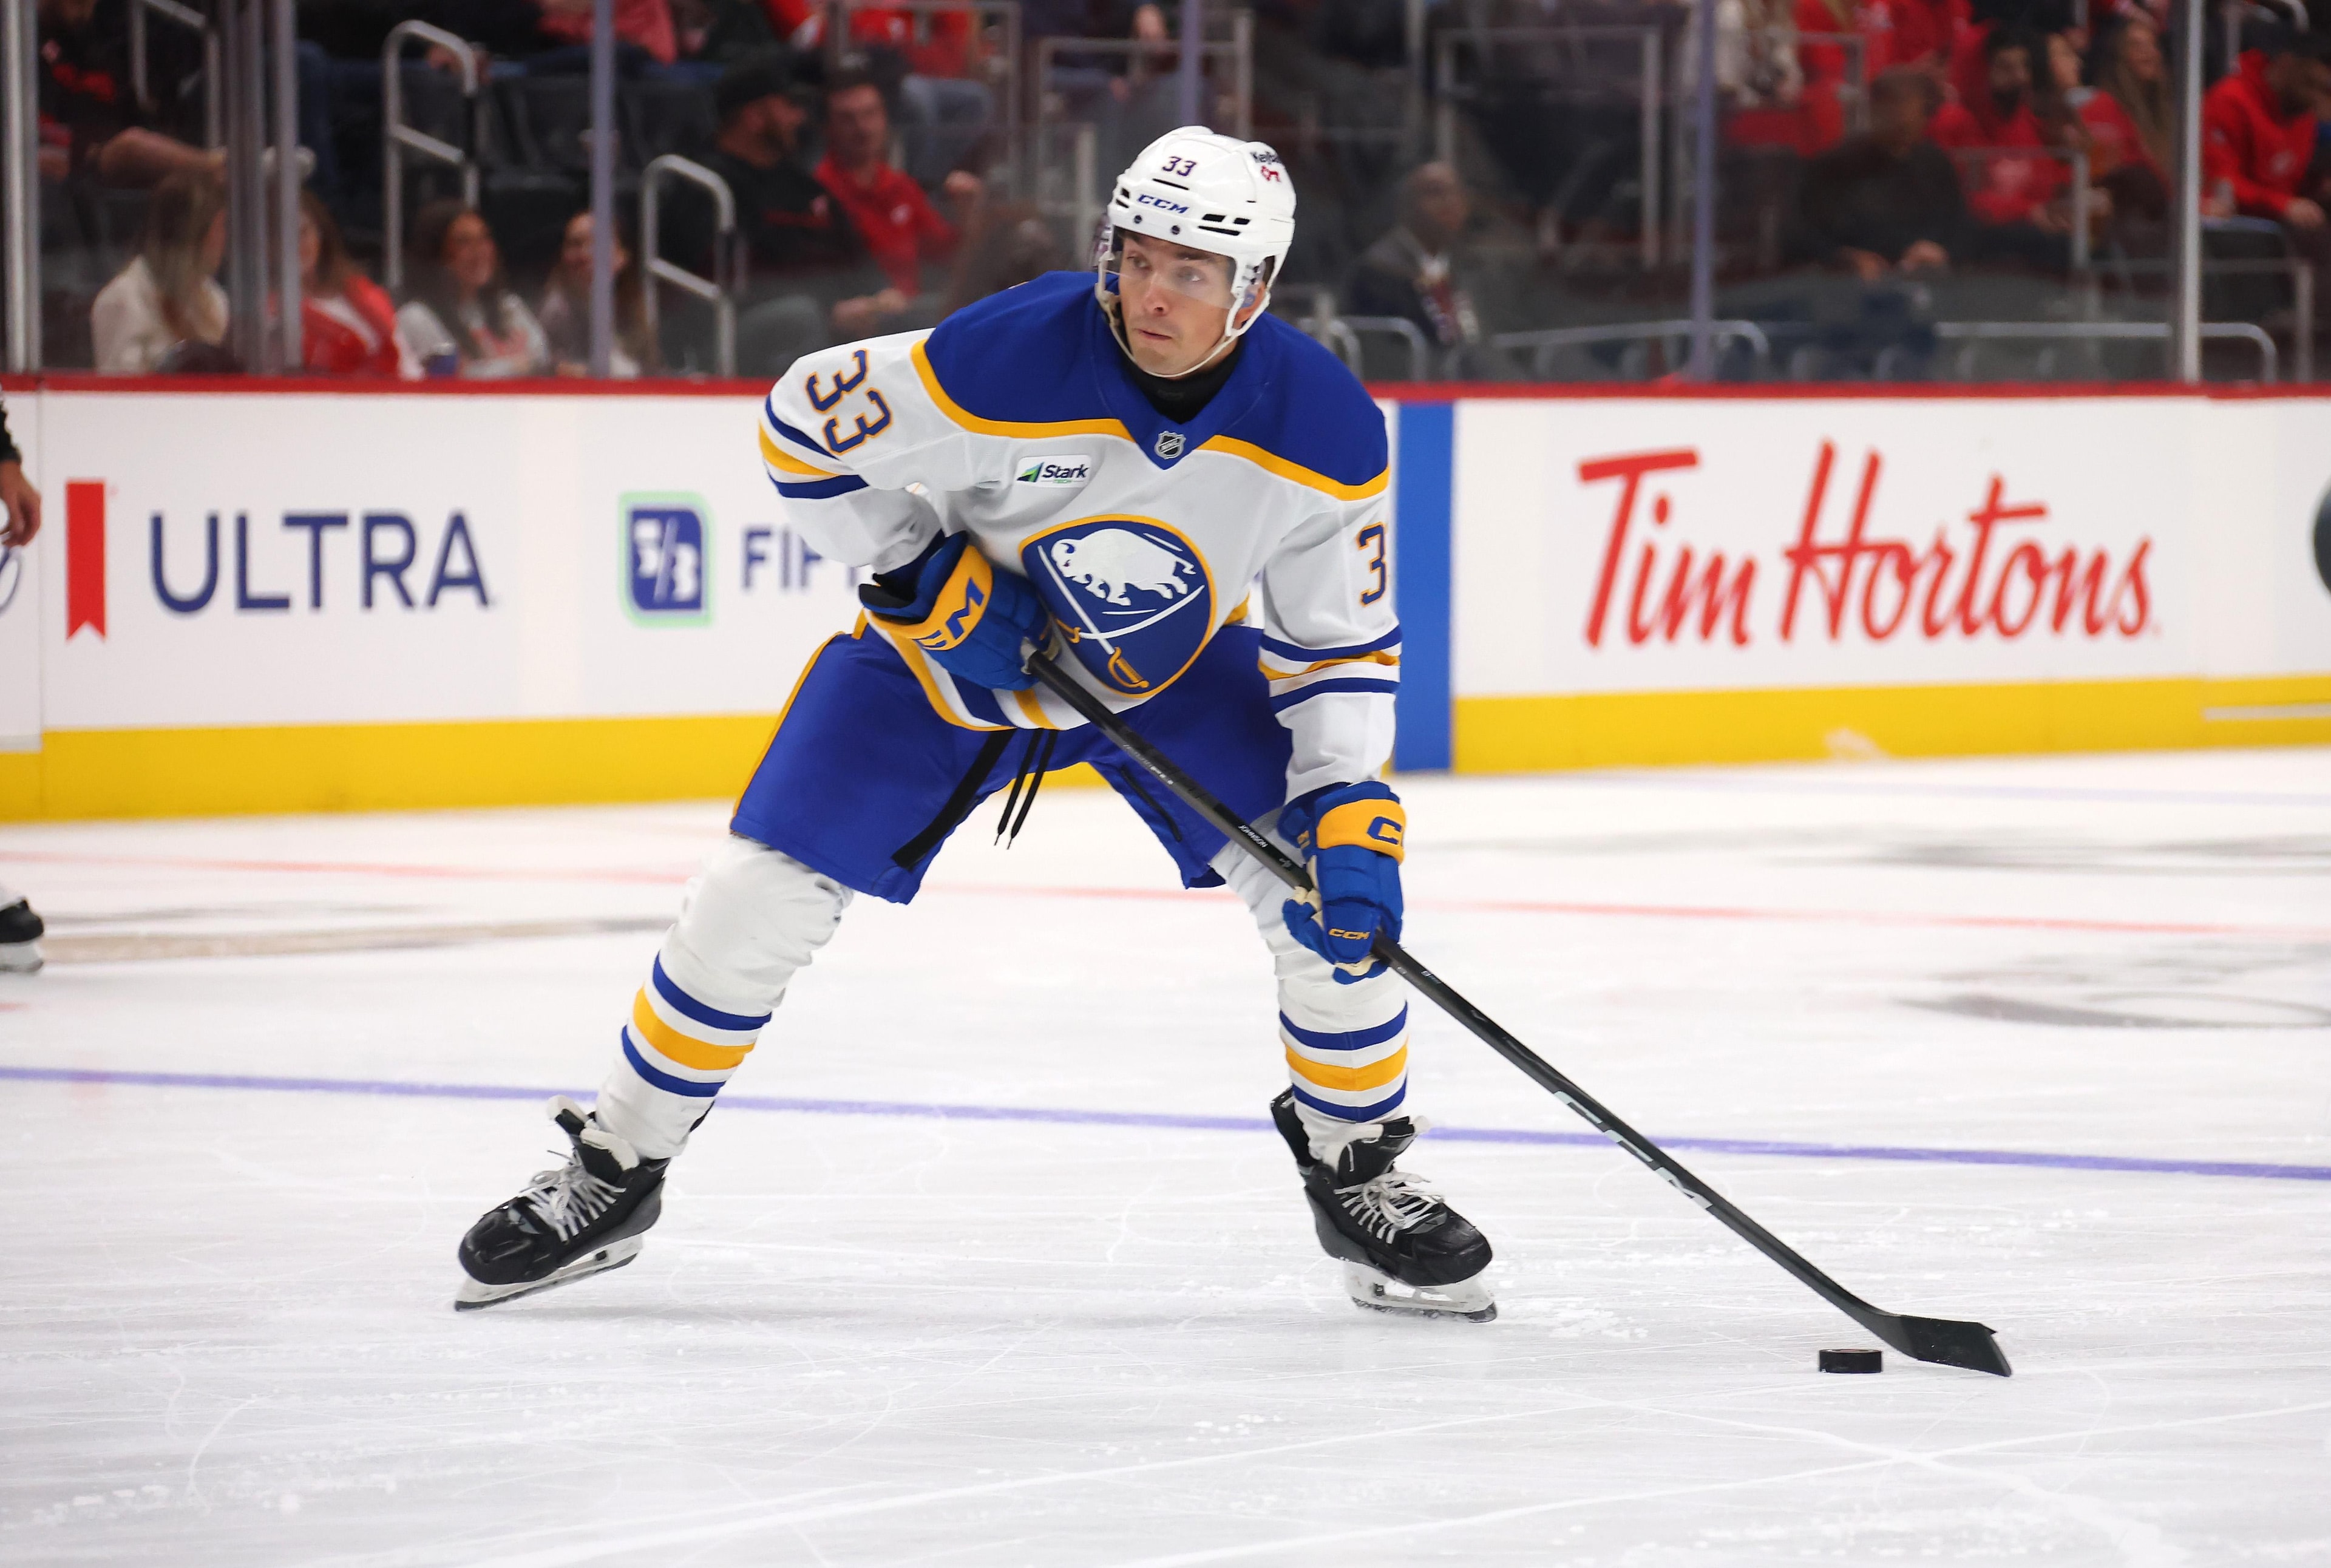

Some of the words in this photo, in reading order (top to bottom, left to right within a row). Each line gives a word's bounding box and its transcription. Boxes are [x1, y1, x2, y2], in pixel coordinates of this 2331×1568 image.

[1162, 156, 1196, 176] 33
[1138, 194, 1190, 213] CCM
[806, 348, 892, 456] 33
[1042, 464, 1089, 478] Stark
[149, 510, 490, 613] ULTRA
[742, 526, 858, 589] FIF
[1356, 521, 1387, 608] 3
[1578, 448, 1757, 650] Tim
[1781, 438, 2153, 642] Hortons
[1328, 928, 1370, 940] CCM
